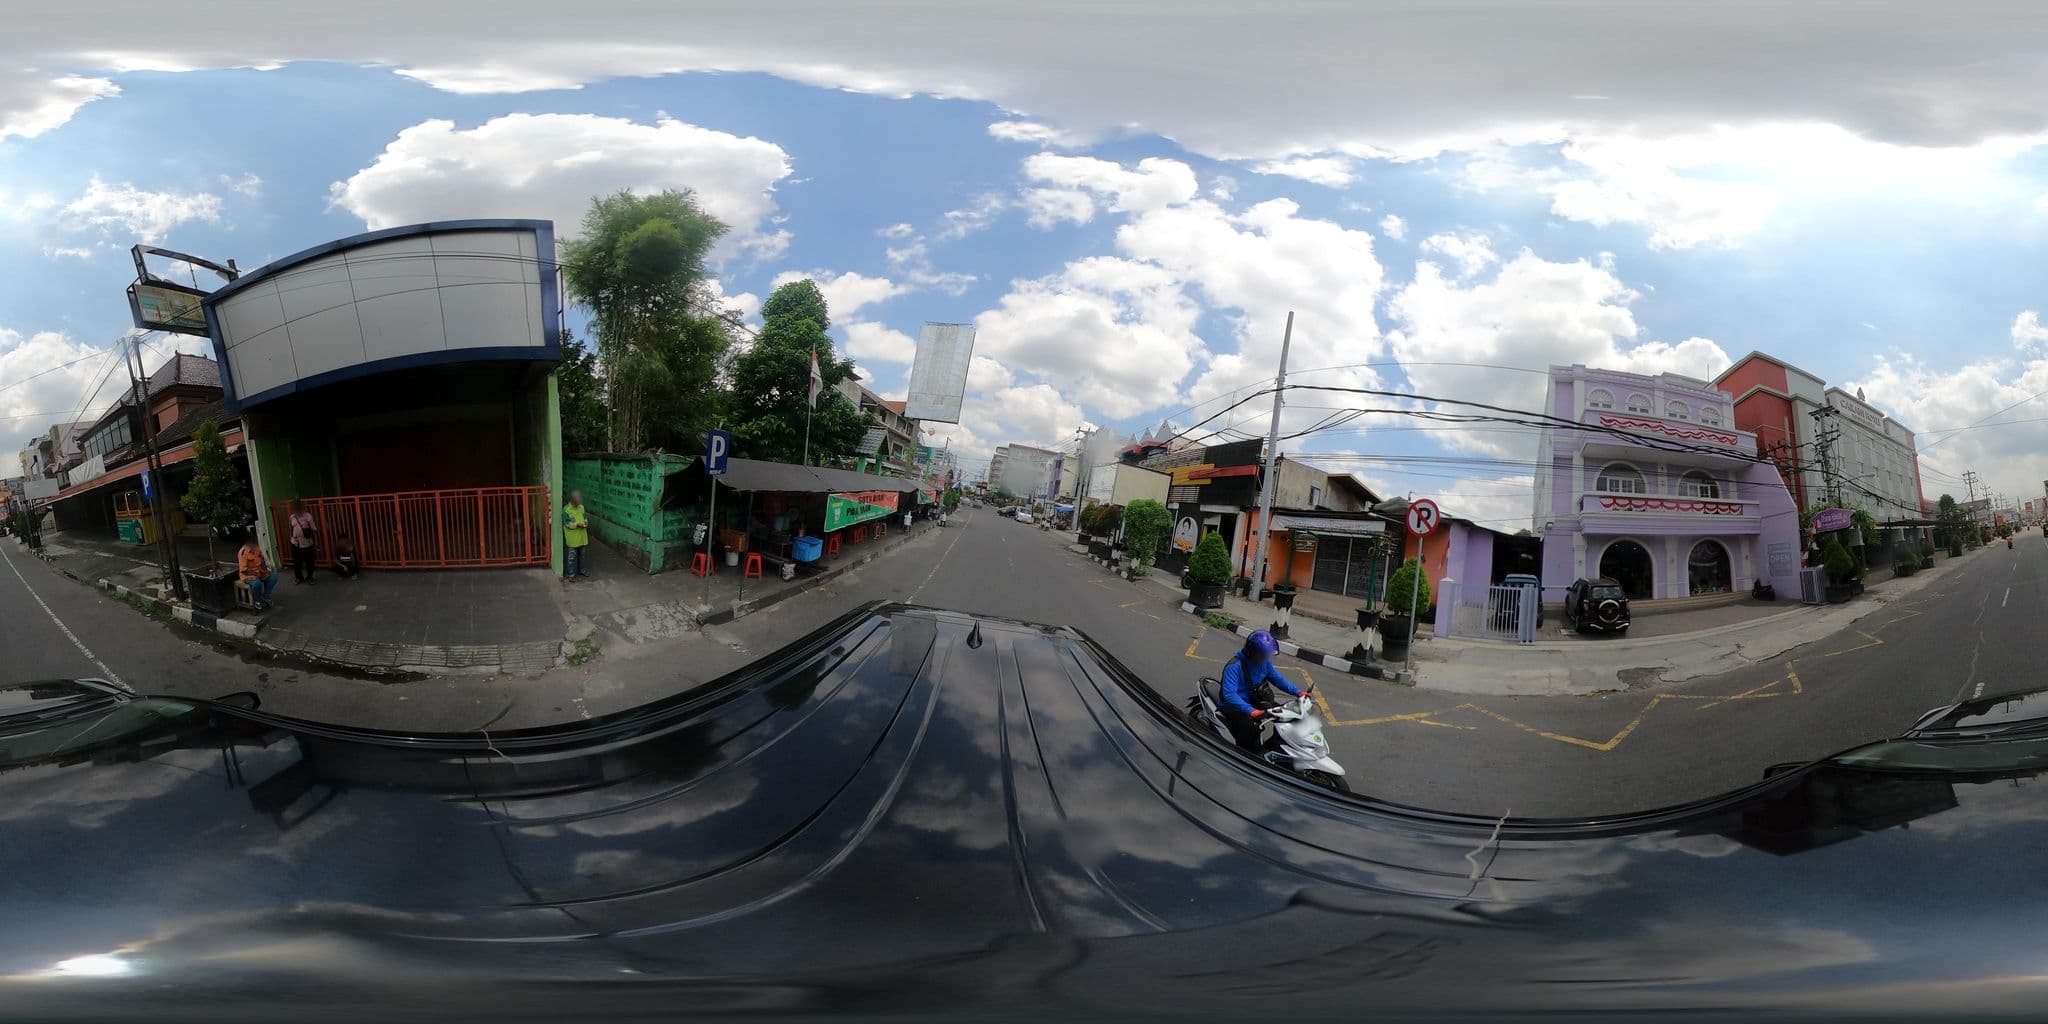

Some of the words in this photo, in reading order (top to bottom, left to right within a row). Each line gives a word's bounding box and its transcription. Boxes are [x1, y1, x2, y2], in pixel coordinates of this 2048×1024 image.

[710, 435, 726, 469] P
[143, 475, 149, 496] P
[1417, 507, 1432, 528] P
